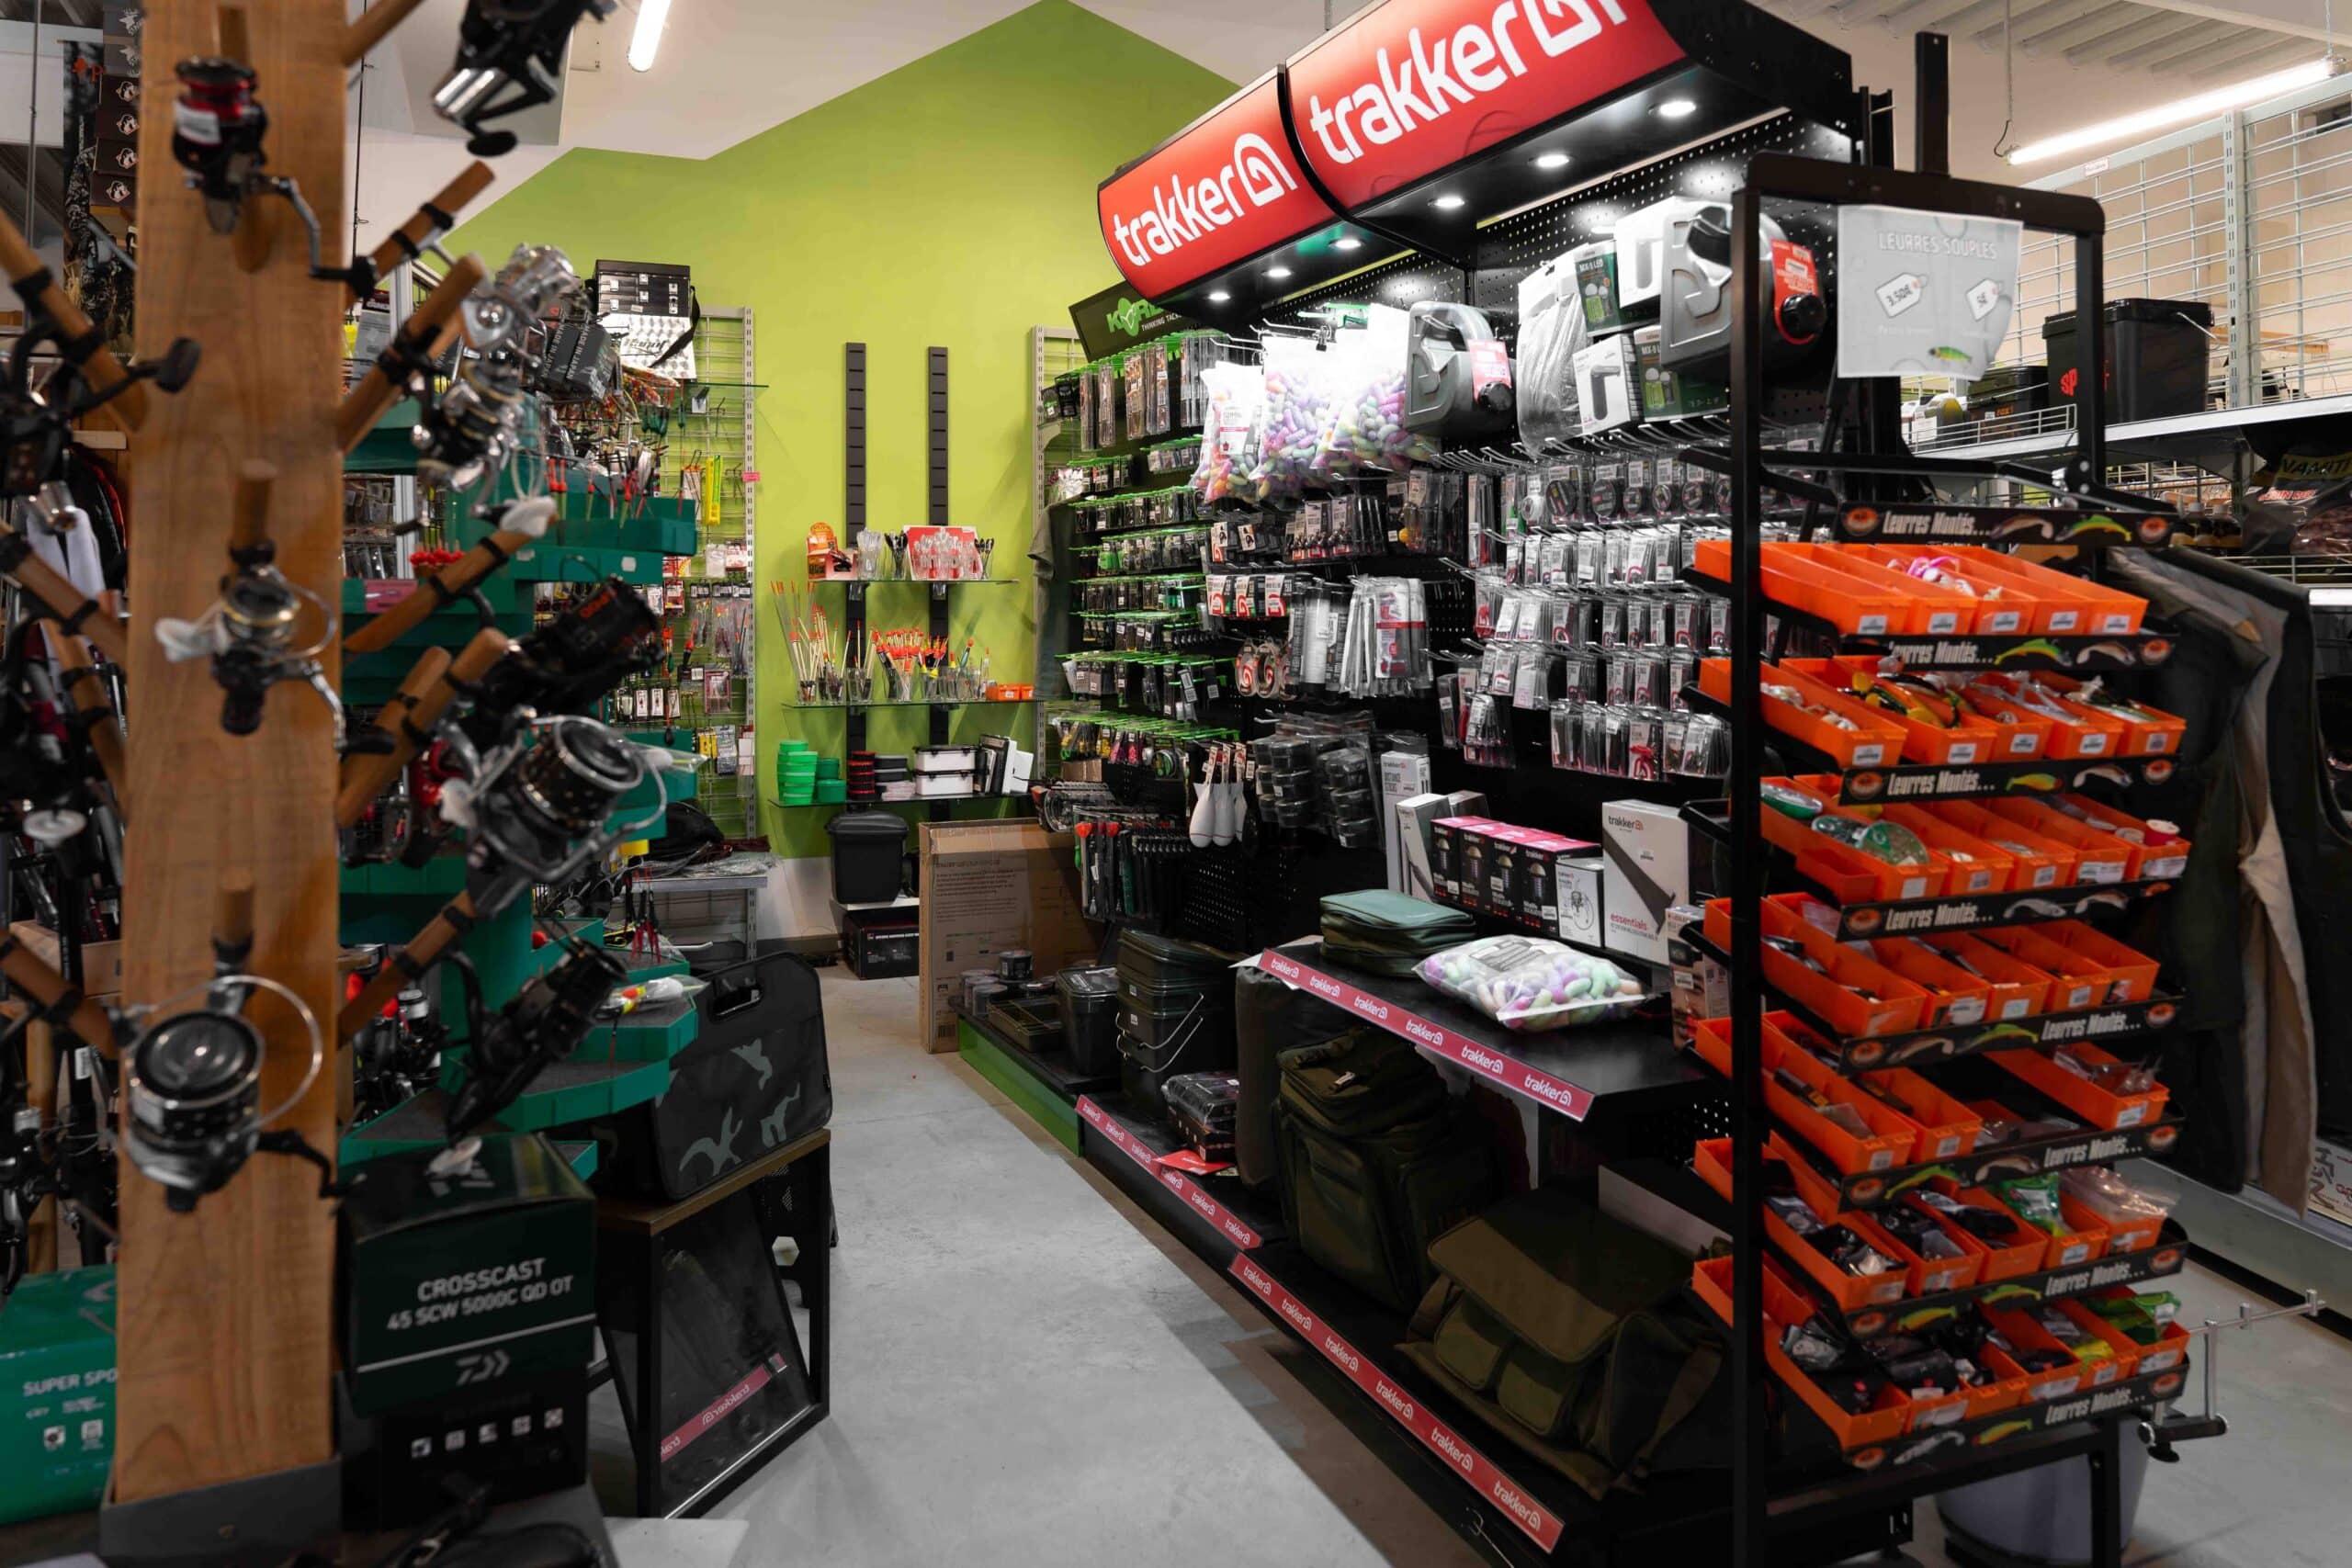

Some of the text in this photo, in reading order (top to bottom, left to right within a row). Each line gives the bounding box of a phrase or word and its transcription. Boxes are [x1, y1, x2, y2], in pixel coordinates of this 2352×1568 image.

[1309, 6, 1529, 164] trakker
[1114, 164, 1242, 266] trakker
[1879, 233, 1997, 259] LEURRES SOUPLES
[1106, 298, 1164, 336] KOR
[1166, 311, 1182, 322] TACK
[1883, 511, 1930, 536] Leurres
[1889, 641, 1934, 664] Lurres
[1887, 773, 1935, 797] Leurres
[1609, 815, 1635, 829] trakker
[1611, 913, 1647, 931] essentials
[1884, 908, 1934, 932] Leurres
[1271, 957, 1293, 976] trakker
[1309, 976, 1333, 996] trakker
[1354, 996, 1380, 1017] trakker
[1406, 1020, 1435, 1043] trakker
[2041, 1017, 2087, 1042] Leurres
[1461, 1045, 1495, 1071] trakker
[1524, 1075, 1562, 1102] trakker
[2043, 1144, 2088, 1168] Leurres
[1192, 1192, 1209, 1213] trakker
[1225, 1219, 1245, 1241] trakker
[417, 1258, 547, 1303] CROSSCAST
[1244, 1266, 1266, 1292] trakker
[2045, 1271, 2090, 1297] Leurres
[387, 1310, 413, 1330] 45
[415, 1301, 459, 1325] SCW
[461, 1289, 518, 1316] 5000C
[520, 1283, 548, 1303] QD
[1282, 1298, 1306, 1325] trakker
[1325, 1336, 1351, 1365] trakker
[23, 1373, 81, 1396] SUPER
[1376, 1380, 1407, 1414] trakker
[2045, 1399, 2090, 1426] Leurres
[1431, 1427, 1464, 1463] trakker
[1494, 1481, 1532, 1521] trakker
